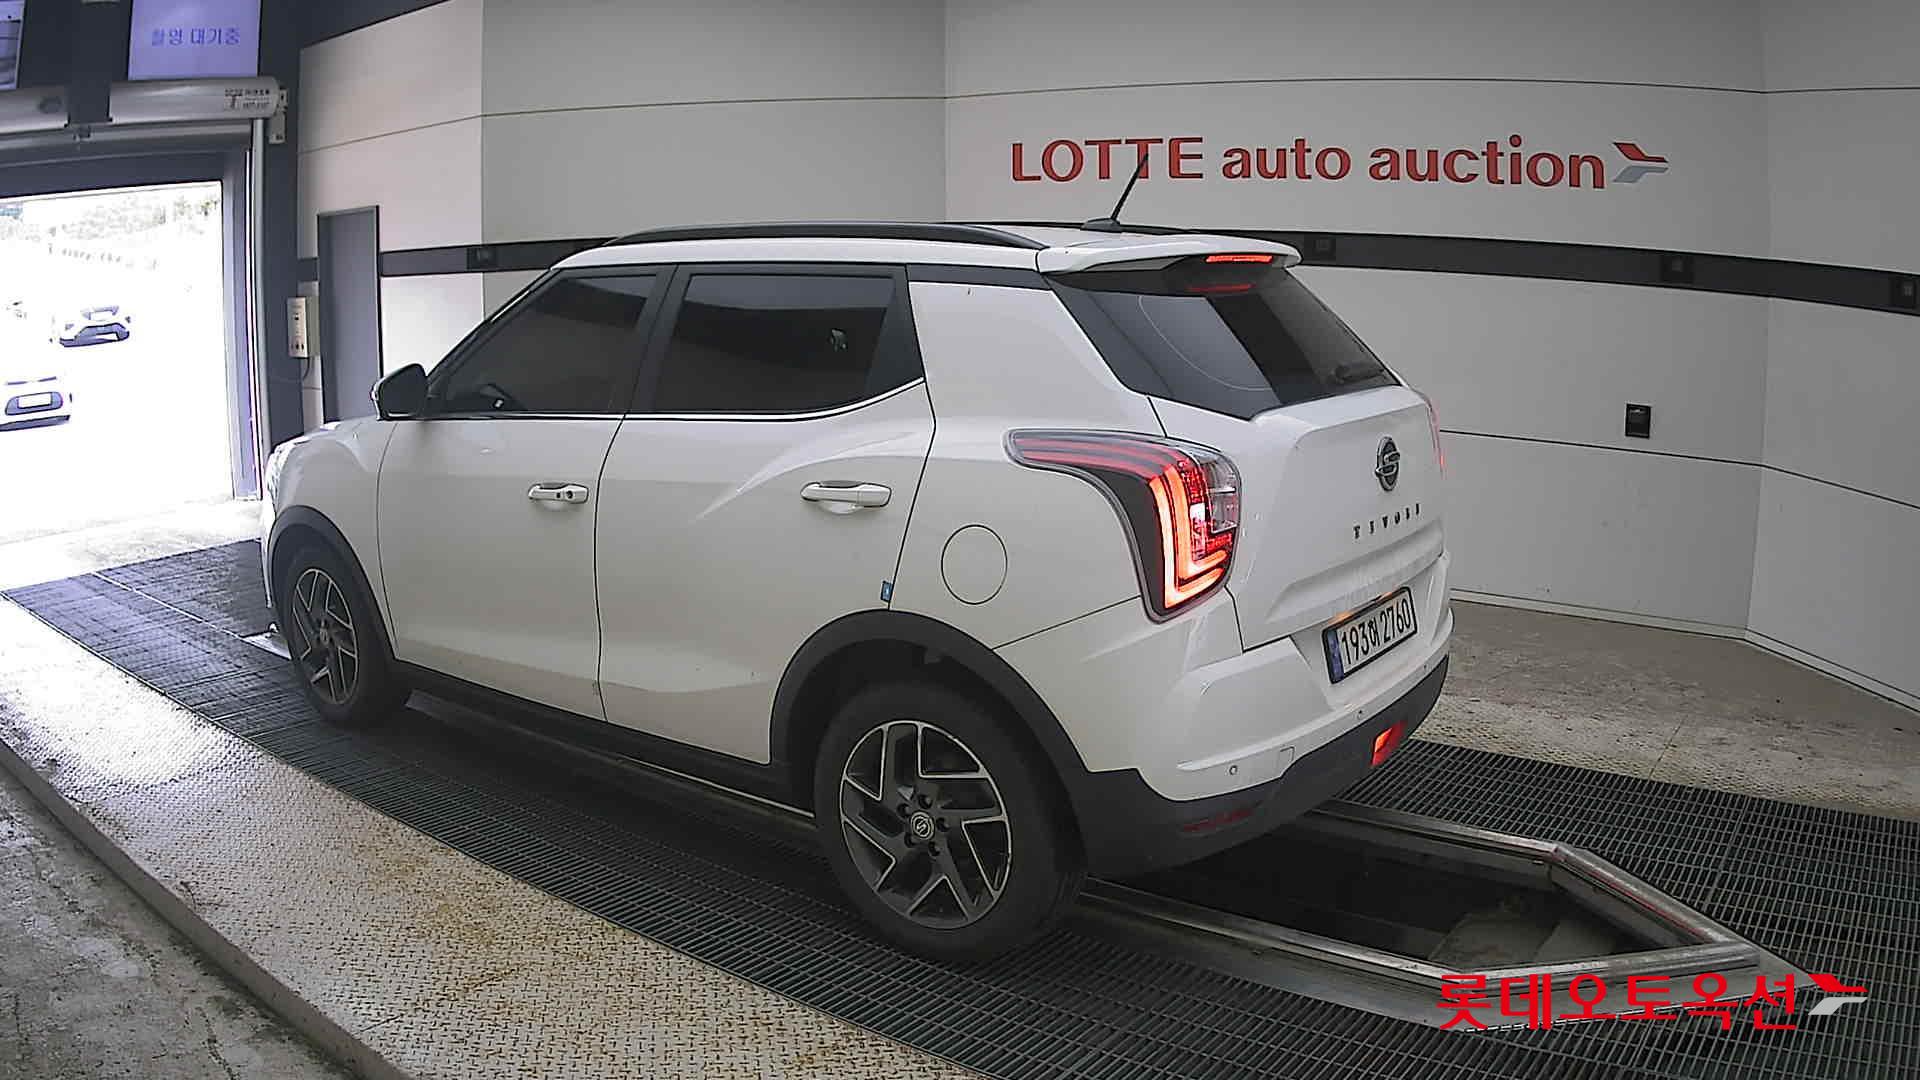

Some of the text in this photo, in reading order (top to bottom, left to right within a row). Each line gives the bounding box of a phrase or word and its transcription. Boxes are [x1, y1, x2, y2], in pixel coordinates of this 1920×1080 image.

[191, 27, 240, 46] 대기중
[1011, 134, 1605, 190] LOTTE auto auction
[1353, 502, 1420, 540] TIVOLI
[1380, 598, 1412, 644] 2760
